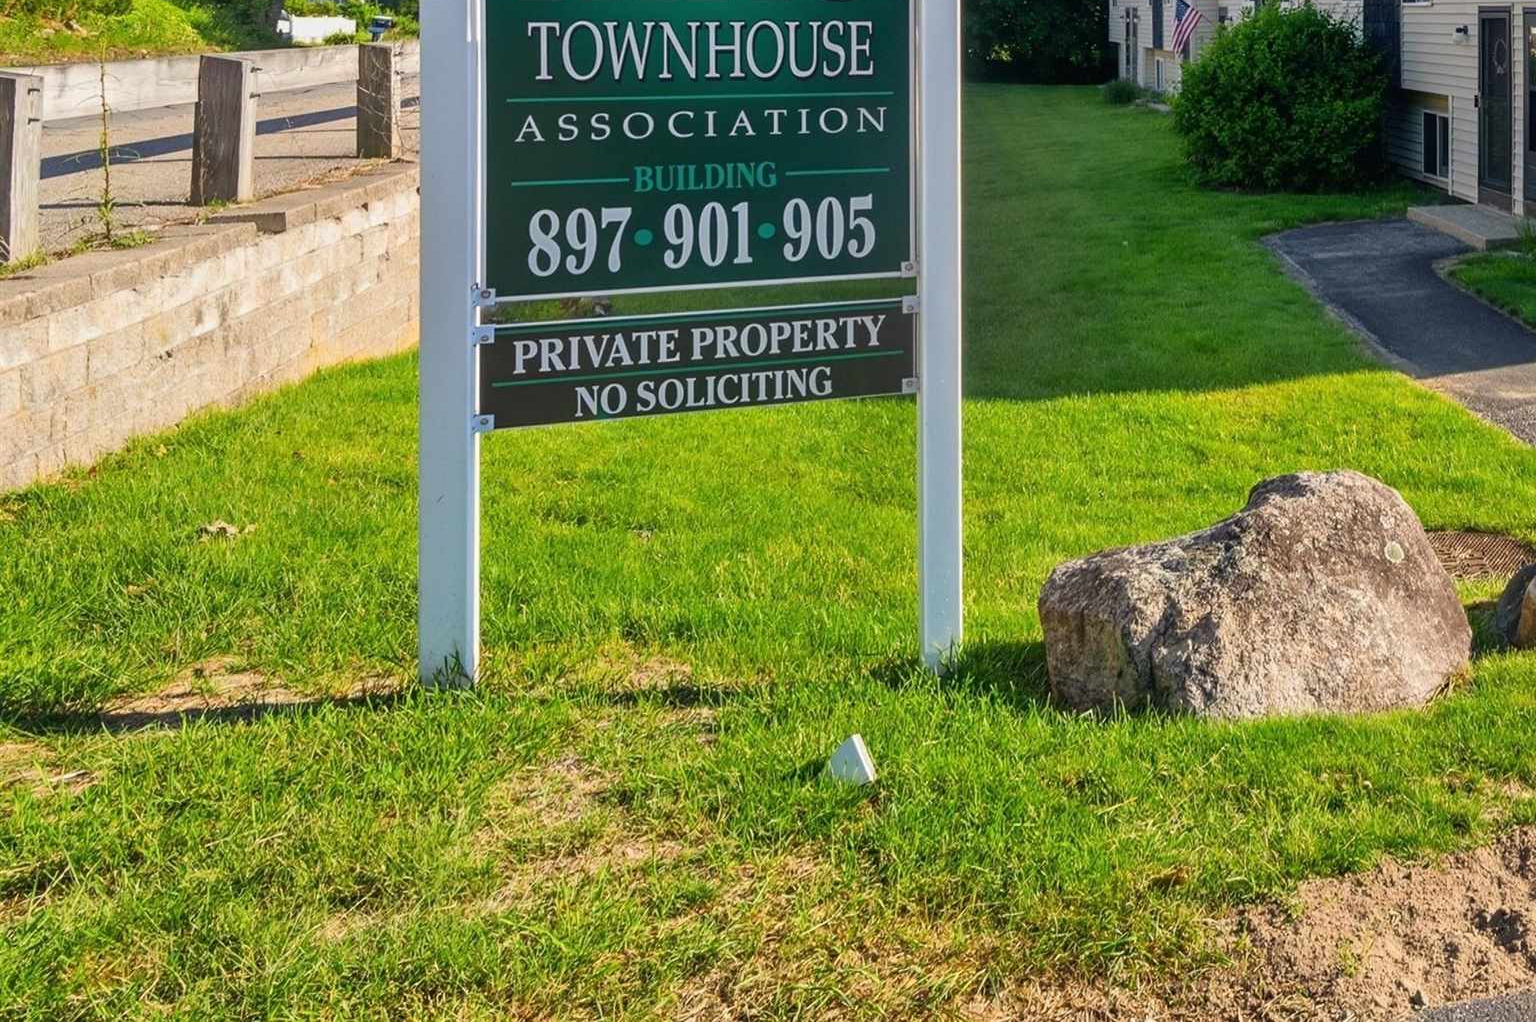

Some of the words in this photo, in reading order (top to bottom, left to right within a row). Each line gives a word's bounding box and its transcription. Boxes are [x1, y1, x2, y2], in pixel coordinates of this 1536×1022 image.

[528, 20, 875, 82] TOWNHOUSE
[515, 107, 887, 143] ASSOCIATION
[633, 161, 778, 193] BUILDING
[528, 207, 633, 277] 897
[663, 201, 753, 269] 901
[783, 193, 876, 262] 905
[512, 328, 681, 375] PRIVATE
[691, 314, 887, 360] PROPERTY
[574, 383, 627, 417] NO
[636, 366, 833, 412] SOLICITING
